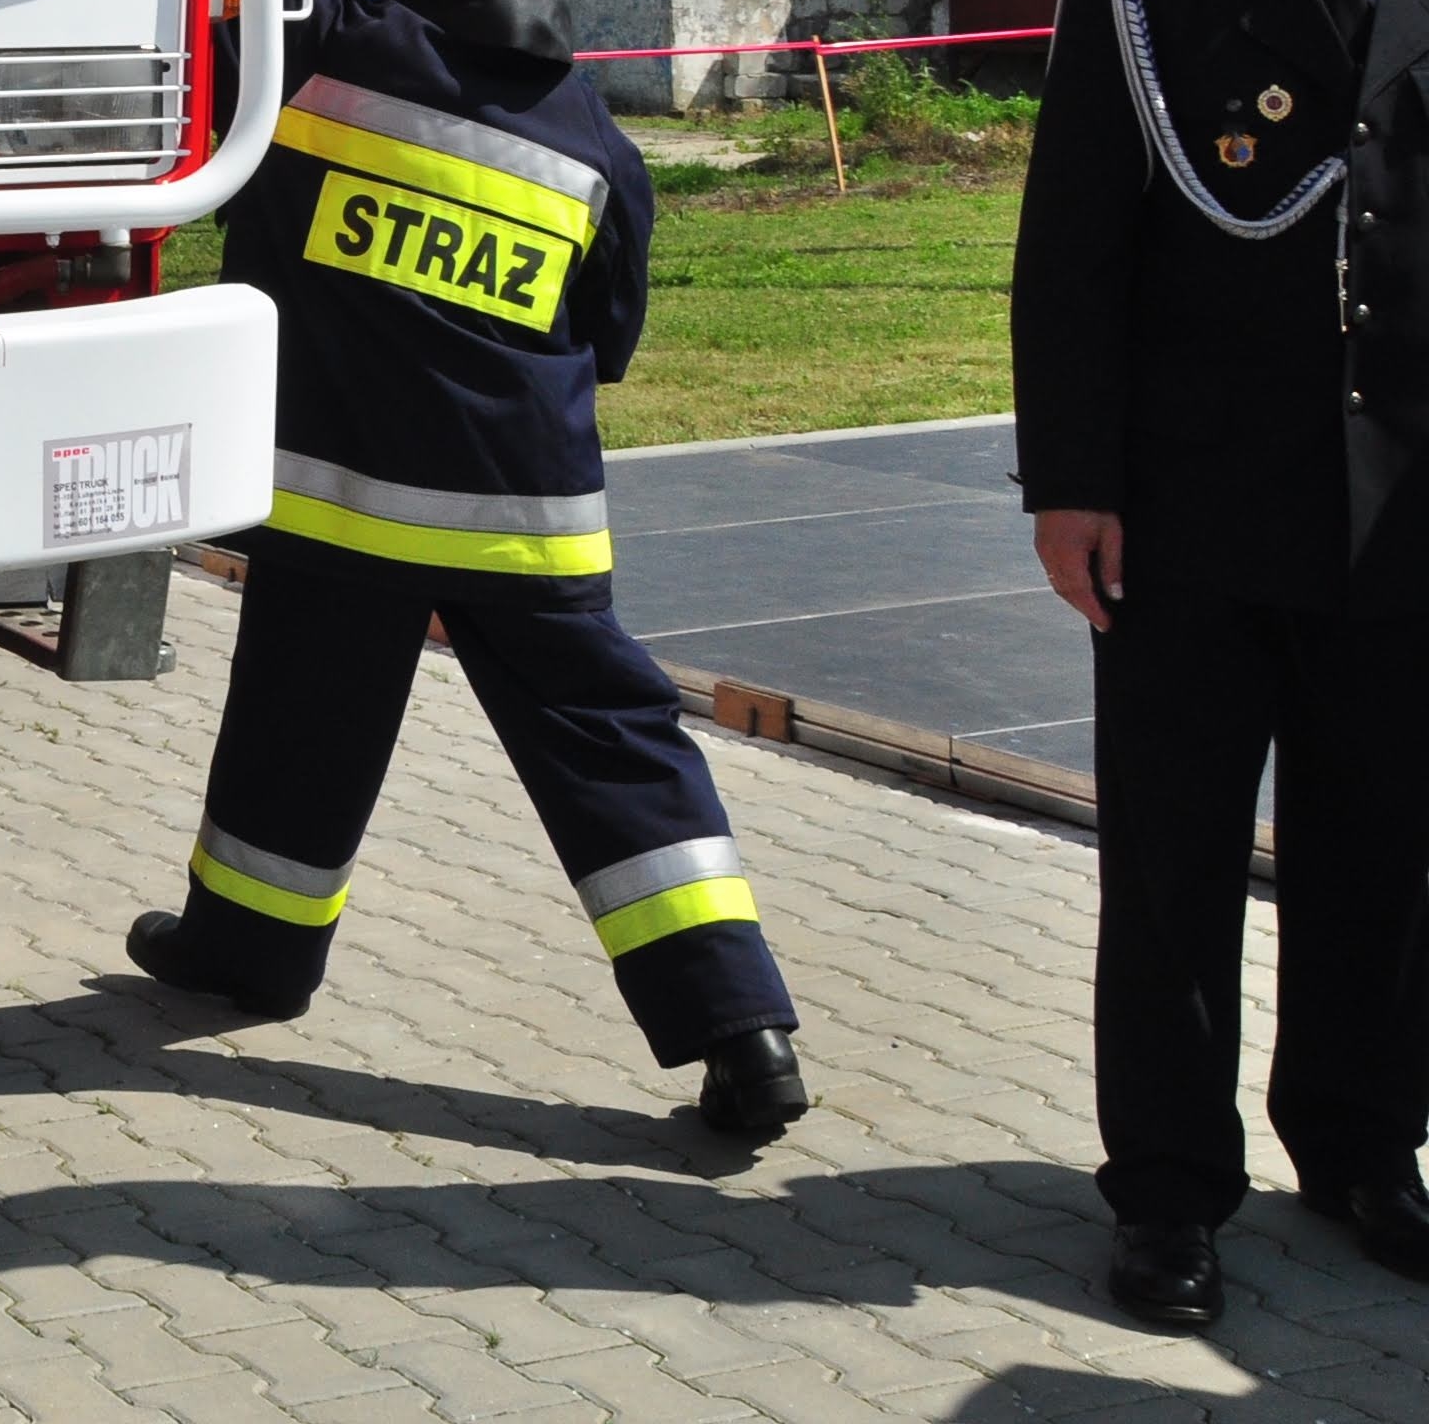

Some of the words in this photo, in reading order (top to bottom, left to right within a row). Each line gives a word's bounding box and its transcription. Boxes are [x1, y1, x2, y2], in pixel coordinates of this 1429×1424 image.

[53, 446, 91, 459] spec
[52, 481, 78, 494] SPEC
[79, 477, 110, 490] TRUCK
